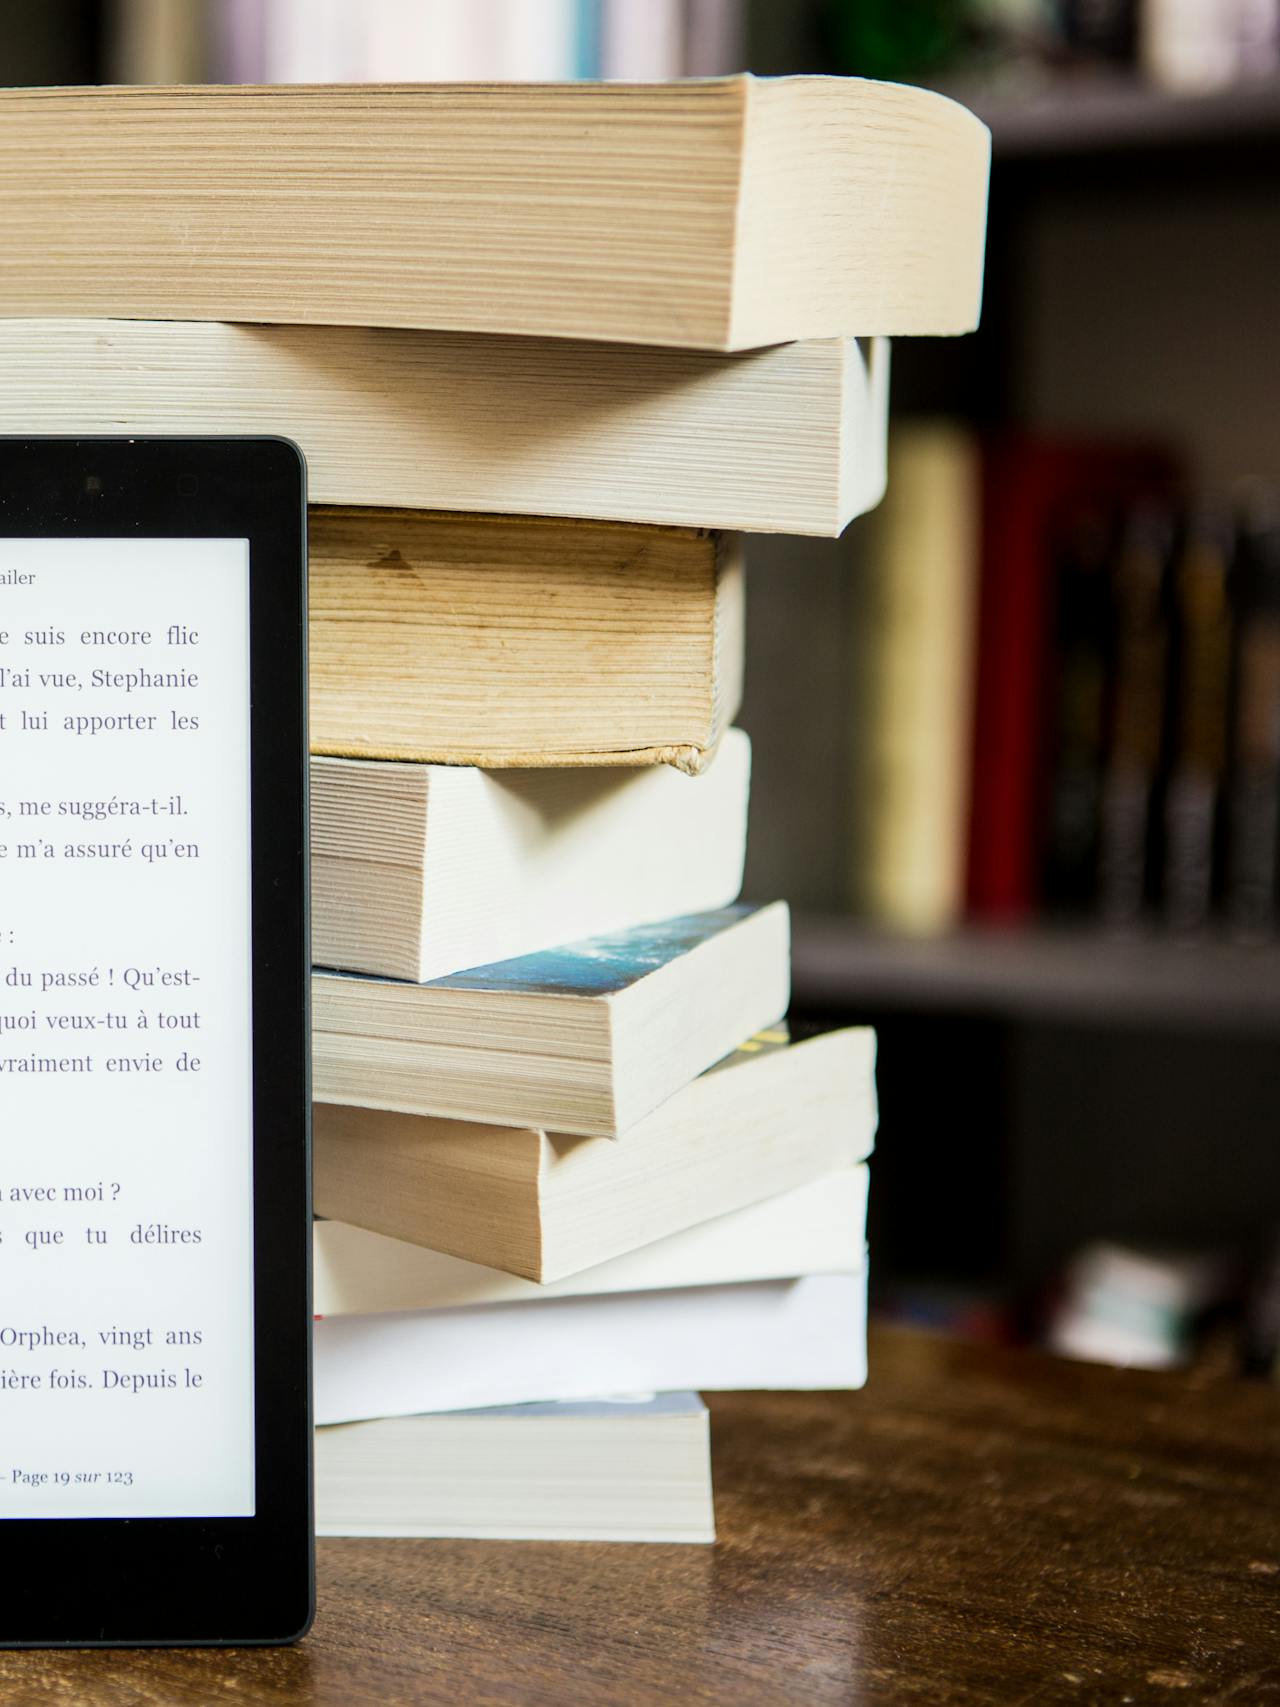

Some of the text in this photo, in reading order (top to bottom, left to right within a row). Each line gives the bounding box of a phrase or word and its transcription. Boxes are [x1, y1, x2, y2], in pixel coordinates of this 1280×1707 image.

[23, 625, 66, 646] suis
[79, 631, 153, 646] encore
[166, 624, 199, 646] flic
[0, 667, 30, 688] l’ai
[38, 673, 83, 692] vue,
[90, 667, 199, 693] Stephanie
[20, 709, 49, 731] lui
[63, 712, 158, 736] apporter
[170, 709, 200, 731] les
[18, 801, 52, 816] me
[57, 794, 188, 821] suggéra-t-il.
[16, 838, 56, 859] m’a
[63, 837, 133, 859] assuré
[140, 838, 200, 864] qu’en
[5, 966, 33, 987] du
[40, 966, 100, 993] passé
[123, 966, 201, 991] Qu’est-
[45, 1012, 128, 1030] veux-tu
[157, 1011, 201, 1030] tout
[105, 1052, 163, 1073] envie
[175, 1051, 201, 1073] de
[9, 1187, 57, 1203] avec
[63, 1181, 103, 1202] moi
[24, 1229, 64, 1250] que
[85, 1227, 108, 1245] tu
[129, 1223, 202, 1245] délires
[0, 1326, 87, 1352] Orphea,
[97, 1325, 153, 1351] vingt
[165, 1330, 203, 1345] ans
[48, 1368, 93, 1390] fois.
[102, 1368, 177, 1394] Depuis
[183, 1367, 203, 1389] le
[12, 1468, 49, 1487] Page
[53, 1471, 71, 1486] 19
[74, 1472, 102, 1484] sur
[106, 1470, 136, 1488] 123
